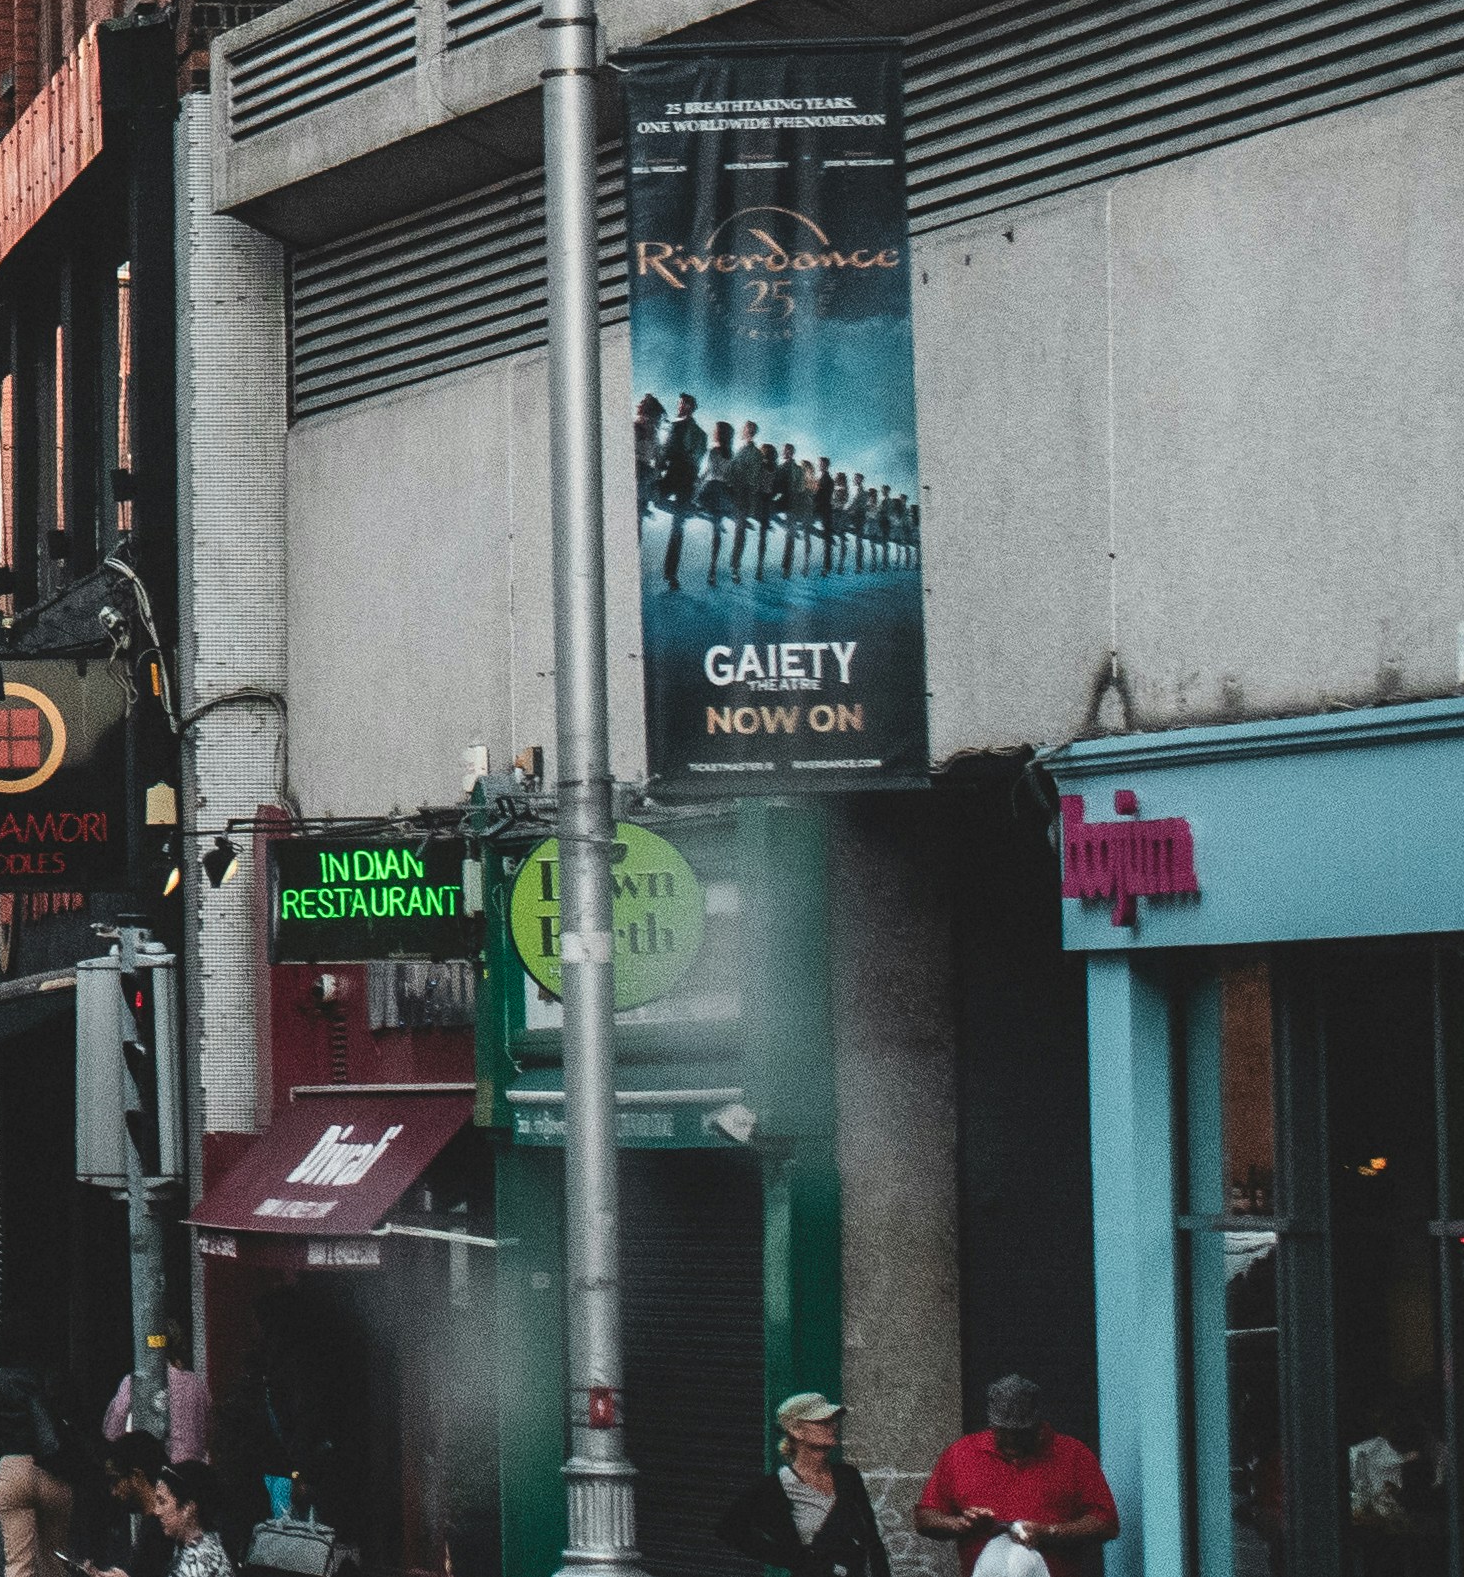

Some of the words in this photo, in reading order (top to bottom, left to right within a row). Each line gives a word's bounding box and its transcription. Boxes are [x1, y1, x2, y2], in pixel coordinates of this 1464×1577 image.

[637, 122, 671, 133] ONE
[674, 118, 770, 132] WORLDWIDE
[773, 114, 886, 128] PHENOMENON
[665, 103, 682, 115] 25
[684, 100, 803, 114] BREATHTAKING
[635, 228, 900, 289] Riverdance
[744, 280, 796, 318] 25
[704, 641, 857, 686] GAIETY
[748, 677, 822, 691] THEATRE
[706, 705, 800, 734] NOW
[808, 703, 864, 732] ON
[319, 849, 425, 883] INDIAN
[281, 885, 460, 920] RESTAURANT
[285, 1124, 404, 1187] Diwali
